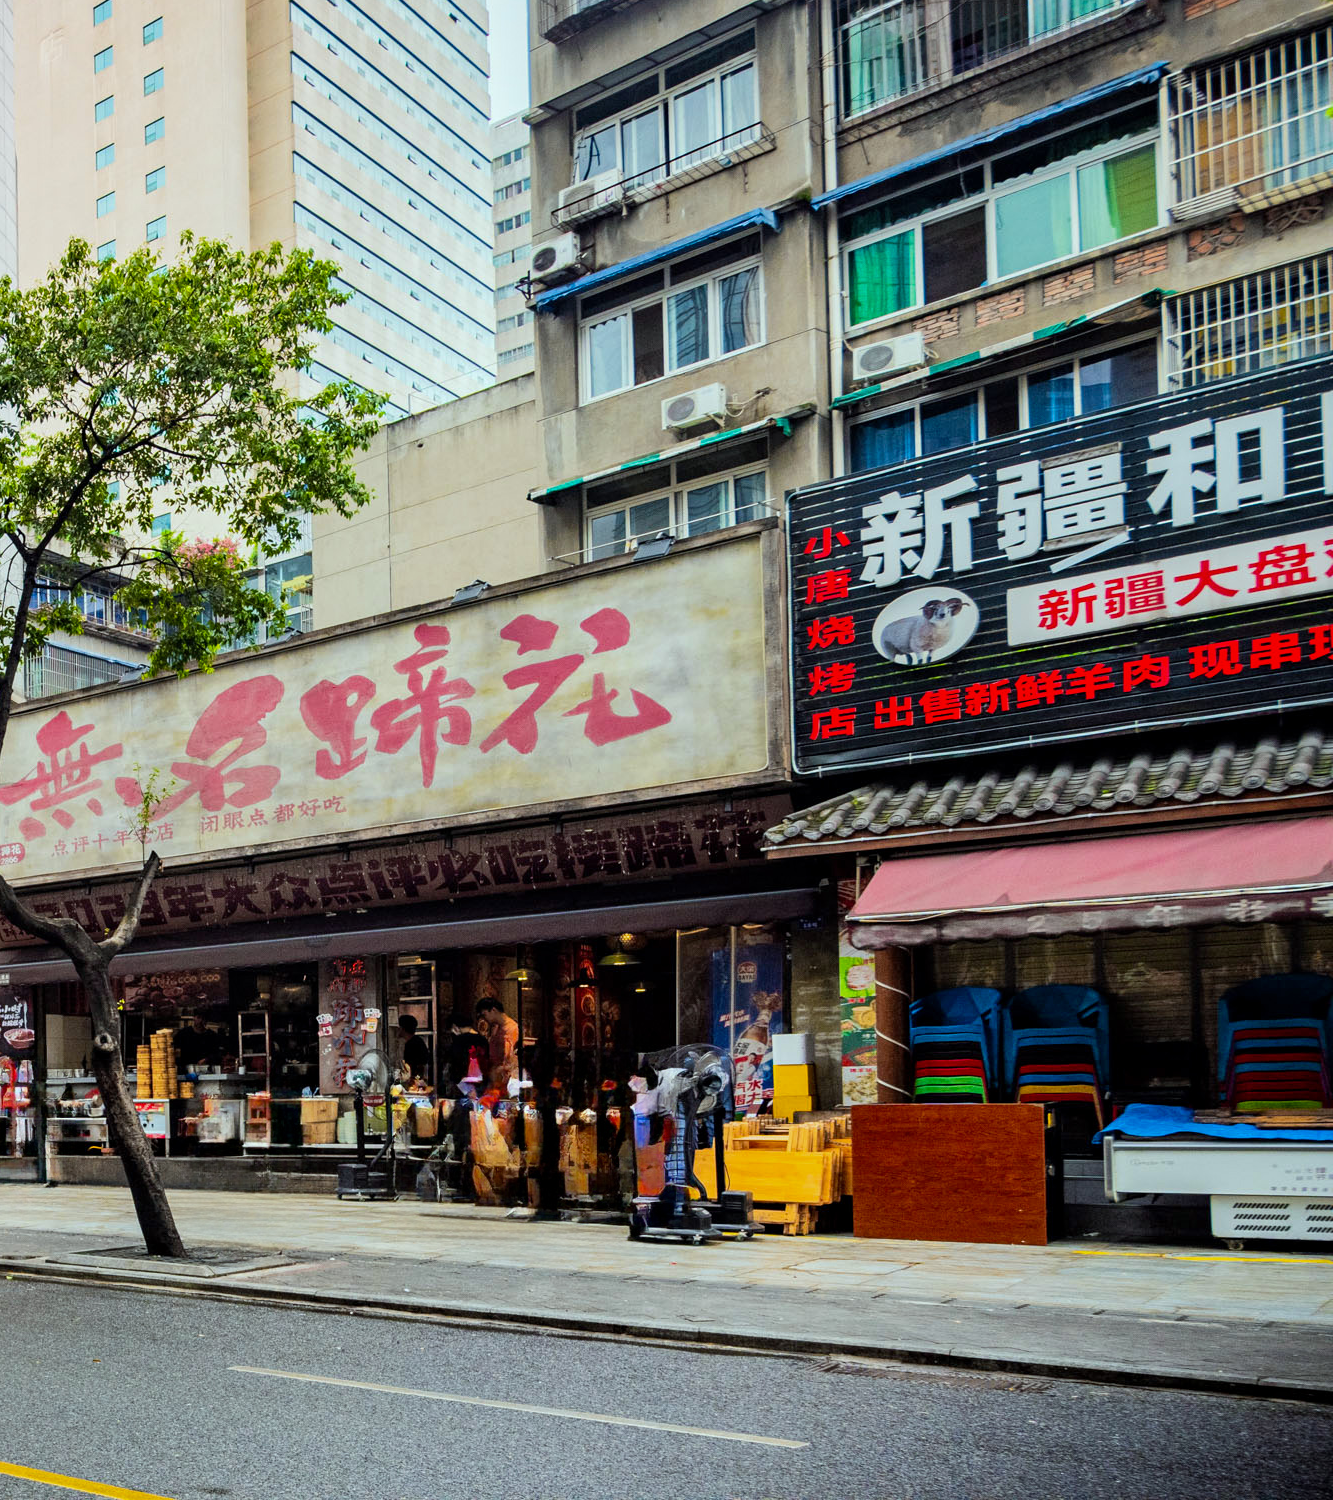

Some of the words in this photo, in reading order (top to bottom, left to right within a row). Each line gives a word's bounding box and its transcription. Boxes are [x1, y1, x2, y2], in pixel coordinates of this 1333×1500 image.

[860, 393, 1333, 588] 新疆和
[1036, 537, 1333, 630] 新疆大盘
[804, 527, 857, 741] 小唐烧烤店
[874, 654, 1170, 731] 出售新鲜羊肉
[51, 822, 174, 858] 点评十年老店
[199, 795, 348, 835] 闭眼点都好吃
